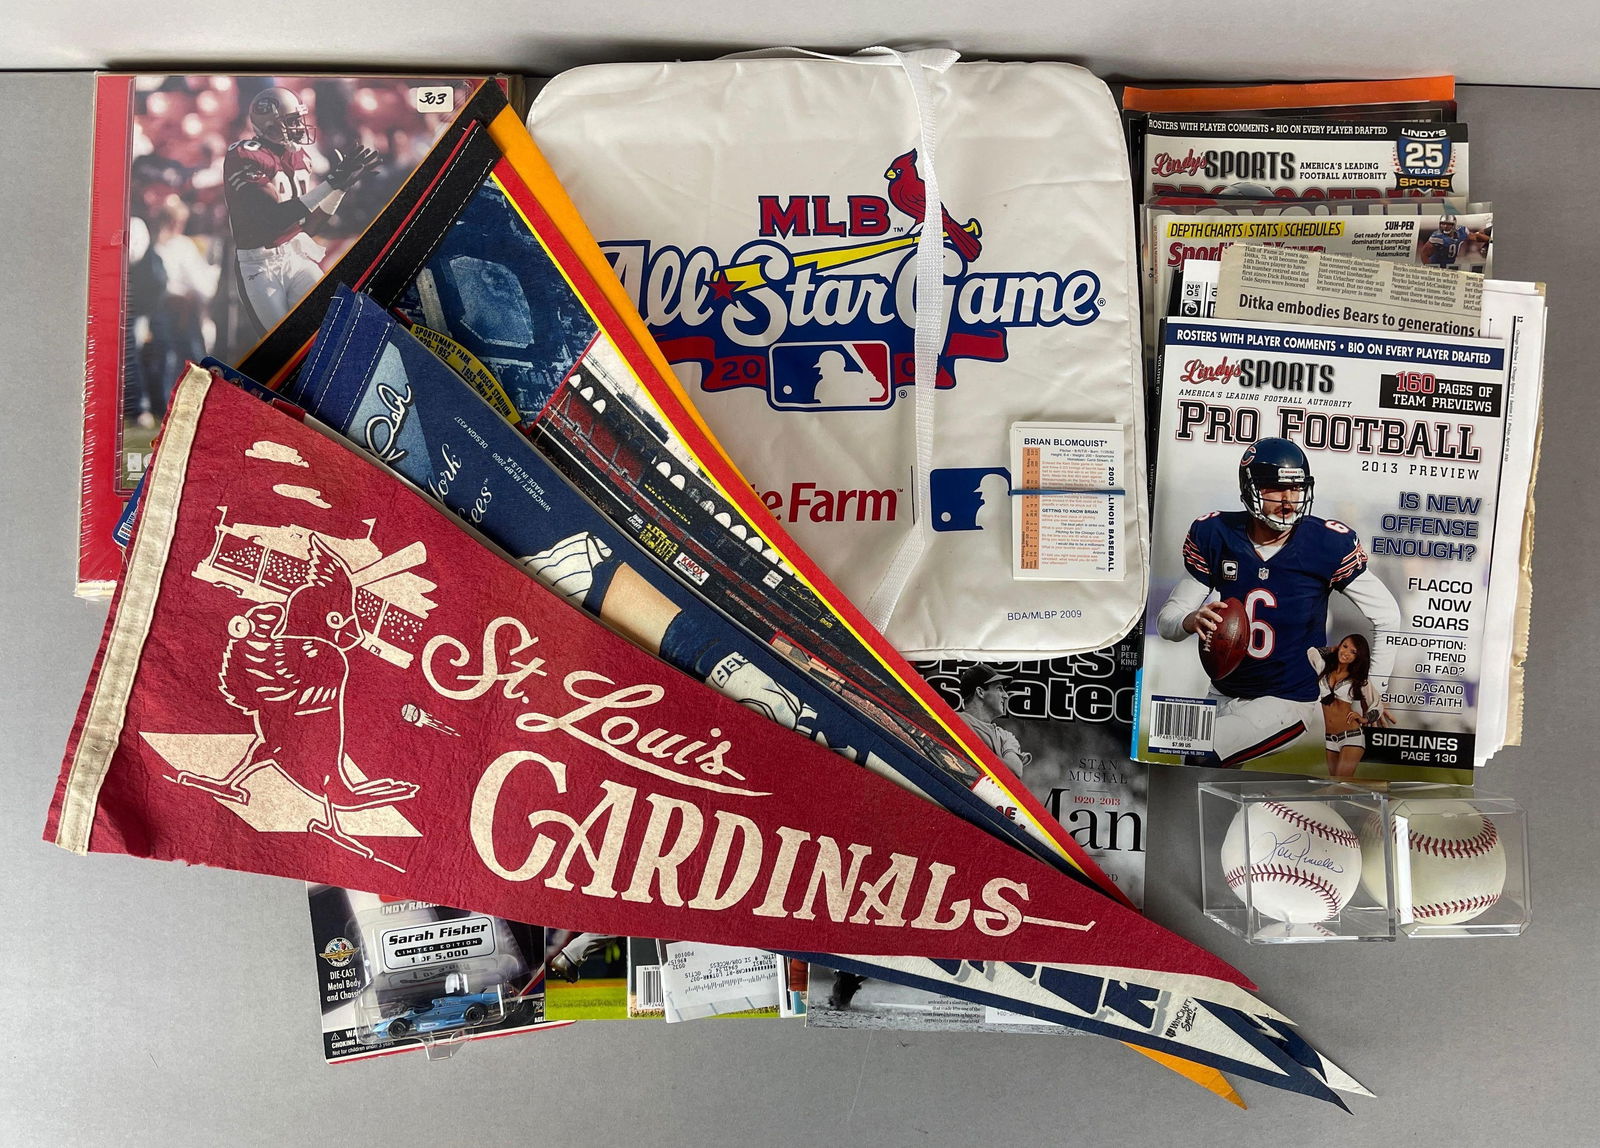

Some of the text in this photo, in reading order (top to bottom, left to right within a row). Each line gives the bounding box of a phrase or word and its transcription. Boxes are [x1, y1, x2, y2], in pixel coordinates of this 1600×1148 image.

[419, 92, 447, 104] 303
[1149, 119, 1388, 135] ROSTERS WITH PLAYER COMMENTS BIO ON EVERY PLAYER DRAFTED
[1401, 128, 1447, 138] LINDY'S
[1405, 142, 1444, 168] 25
[1151, 148, 1296, 180] Lindy's SPORTS
[1300, 162, 1342, 170] AMERICA'S
[1300, 172, 1388, 180] FOOTBALL AUTHORITY
[1400, 178, 1450, 187] SPORTS
[757, 194, 892, 240] MLB
[1170, 222, 1342, 237] DEPTH CHARTS STATS SCHEDULES
[1385, 221, 1414, 230] SUH-PER
[717, 241, 897, 347] Star
[893, 241, 1100, 346] Game
[1186, 284, 1194, 296] 20
[1239, 293, 1474, 338] Ditka embodies Bears to generations
[1177, 330, 1491, 364] ROSTERS WITH PLAYER COMMENTS BIO ON EVERY PLAYER DRAFTED
[414, 326, 457, 353] SPORTSMAN'S
[456, 348, 472, 366] PARK
[476, 368, 494, 391] BUSCH
[492, 388, 512, 417] STADIUM
[722, 359, 762, 381] 20
[1180, 356, 1336, 394] Lindy's SPORTS
[1396, 370, 1494, 398] 160 PAGES OF
[1178, 388, 1352, 408] AMERICA'S LEADING FOOTBALL AUTHORITY
[1393, 394, 1492, 413] TEAM PREVIEWS
[454, 416, 489, 449] DESIGN #337
[1175, 398, 1482, 464] PRO FOOTBALL
[1362, 460, 1480, 480] 2013 PREVIEW
[492, 452, 552, 512] WINCRAFT MLBP 2000
[526, 478, 545, 496] MADE
[788, 482, 897, 522] Farm
[1399, 491, 1482, 515] IS NEW
[1381, 514, 1480, 539] OFFENSE
[1371, 536, 1478, 562] ENOUGH?
[681, 556, 705, 577] KMOX
[1408, 577, 1473, 594] FLACCO
[1428, 597, 1472, 613] NOW
[1008, 610, 1082, 621] BDA/MLBP 2009
[1412, 615, 1469, 631] SOARS
[1244, 588, 1278, 660] 6
[1386, 636, 1467, 651] READ-OPTION:
[421, 616, 547, 704] St.
[1120, 652, 1138, 660] PETE
[1426, 652, 1466, 664] TREND
[1414, 664, 1466, 676] OR FAD?
[1414, 683, 1464, 695] PAGANO
[1380, 694, 1462, 708] SHOWS FAITH
[515, 670, 772, 798] Louis
[1372, 732, 1458, 751] SIDELINES
[1079, 758, 1120, 770] STAN
[1400, 751, 1458, 764] PAGE 130
[1069, 770, 1128, 784] MUSIAL
[469, 749, 1098, 938] CARDINALS
[382, 903, 408, 915] INDY
[389, 924, 488, 946] Sarah Fisher
[396, 940, 478, 956] LIMITED EDITION
[435, 949, 468, 960] 5,000
[330, 968, 357, 980] DIE-CAST
[327, 979, 361, 991] Metal Body
[326, 992, 338, 1002] and
[331, 1040, 356, 1049] CHOKING
[348, 1046, 366, 1054] children
